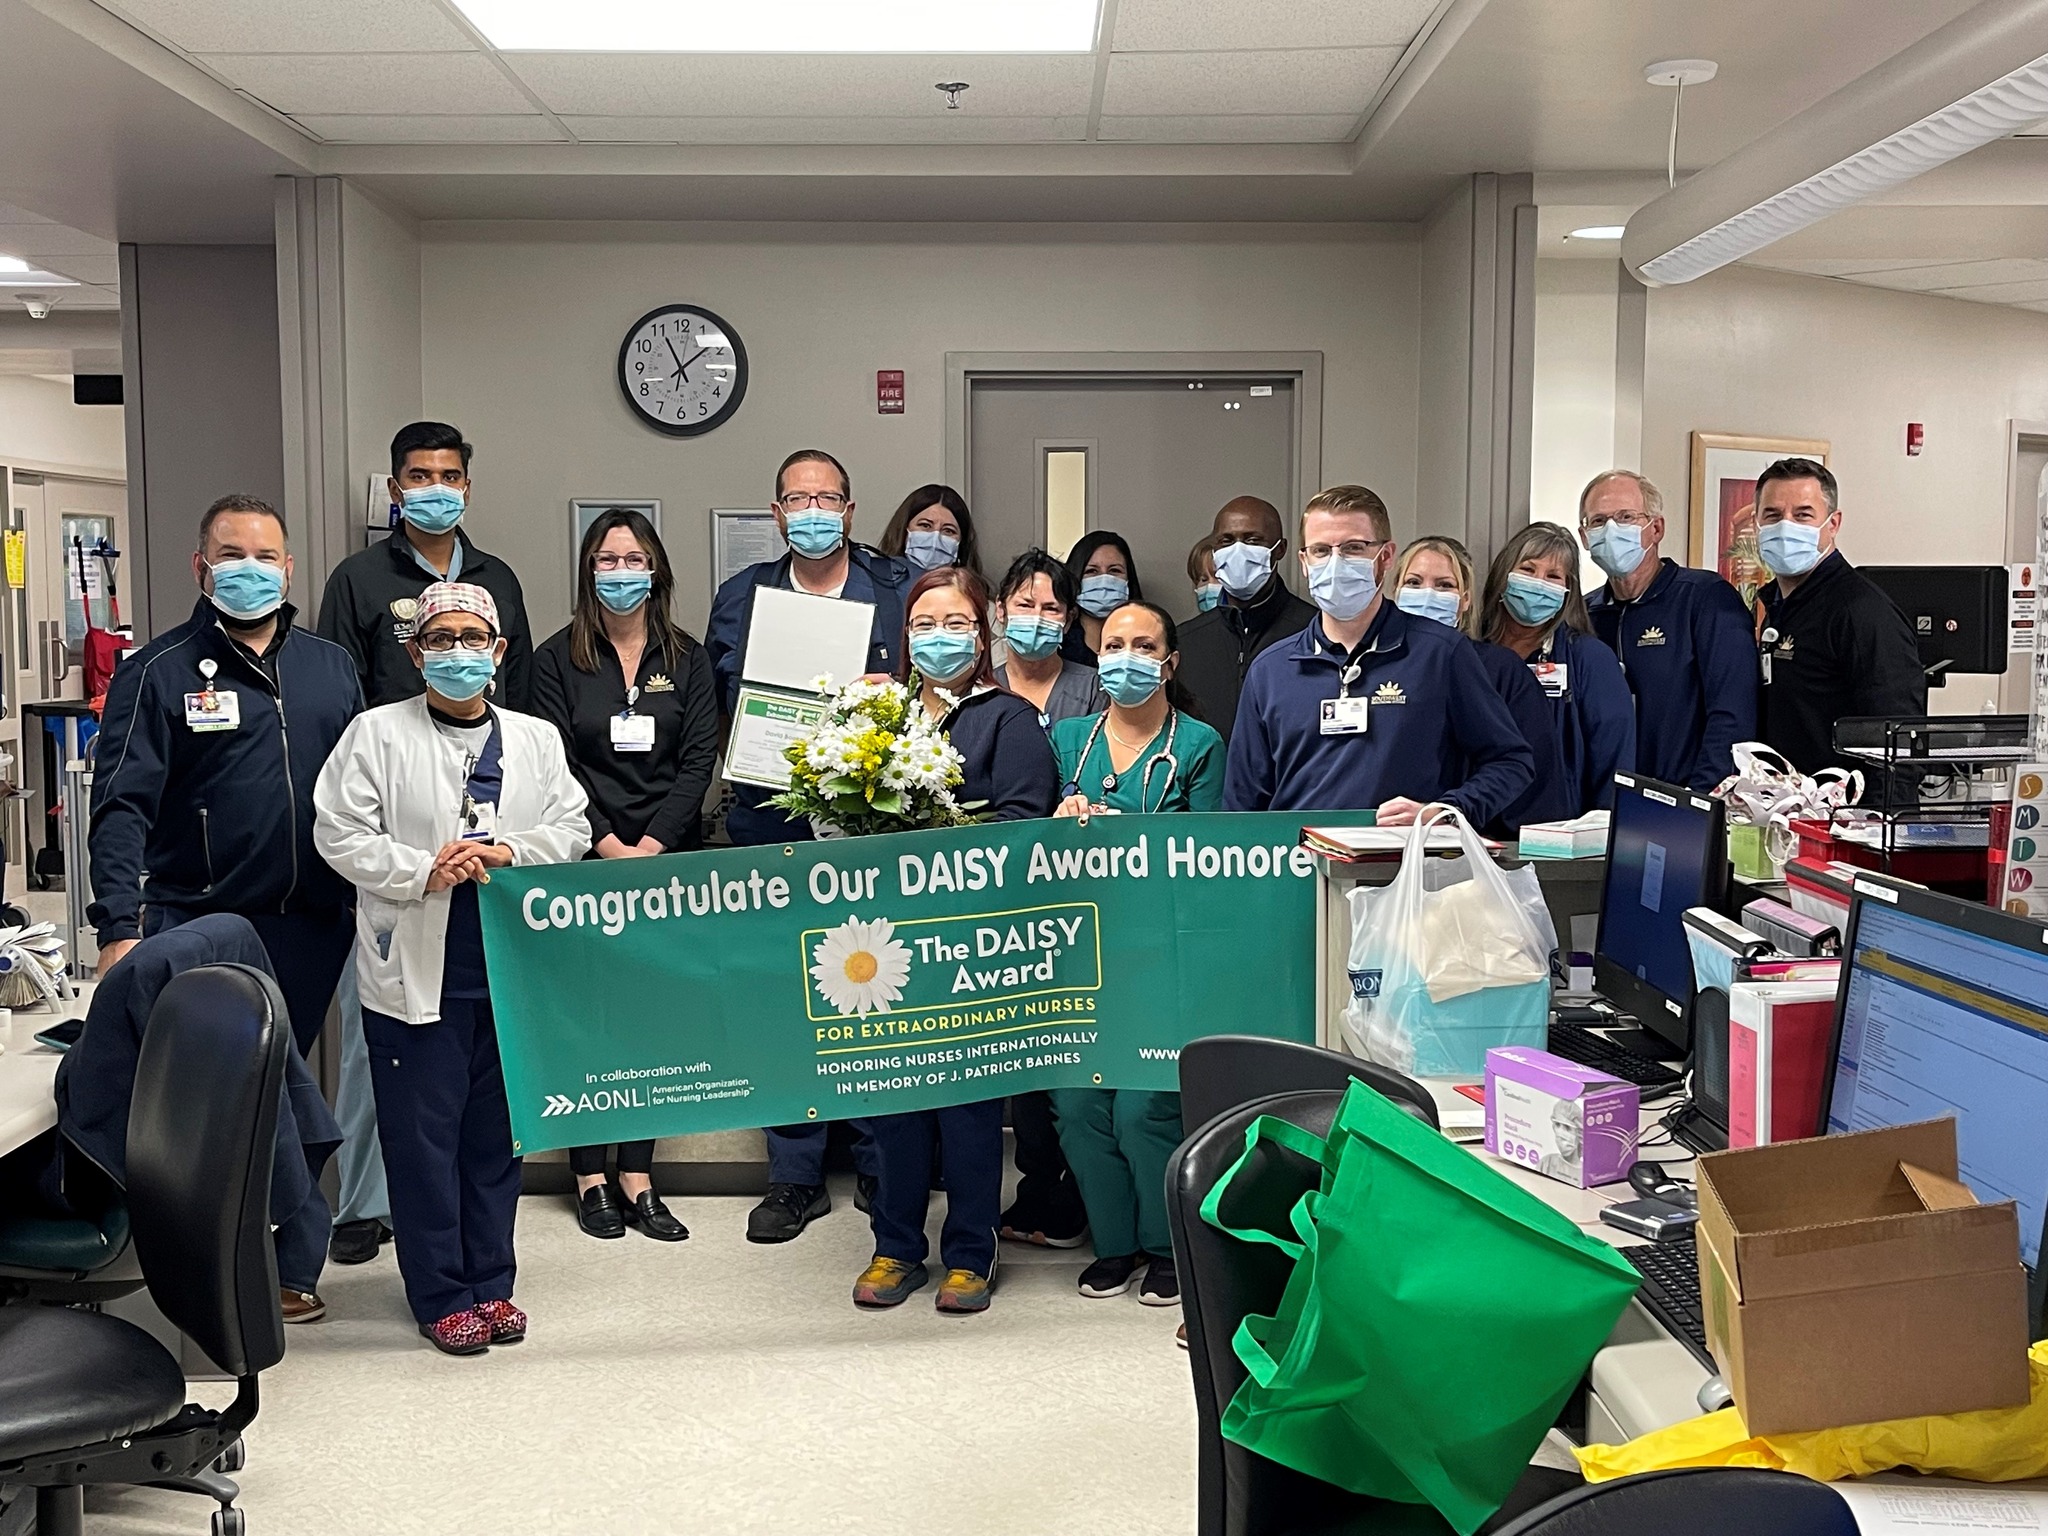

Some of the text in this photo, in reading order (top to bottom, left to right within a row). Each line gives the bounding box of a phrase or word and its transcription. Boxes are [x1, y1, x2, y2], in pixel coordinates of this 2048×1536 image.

[651, 323, 665, 337] 11
[673, 319, 690, 333] 12
[635, 339, 652, 353] 10
[635, 361, 645, 375] 9
[640, 382, 650, 396] 8
[712, 385, 721, 398] 4
[881, 389, 900, 398] FIRE
[656, 401, 664, 414] 7
[676, 406, 686, 420] 6
[699, 402, 708, 416] 5
[2023, 776, 2032, 796] S
[2017, 808, 2031, 826] M
[2018, 839, 2026, 859] T
[522, 869, 791, 936] Congratulate
[808, 861, 880, 904] Our
[898, 845, 1009, 896] DAISY
[1027, 834, 1149, 884] Award
[2010, 870, 2027, 888] W
[914, 916, 1083, 963] The DAISY
[816, 997, 1096, 1042] FOR EXTRAORDINARY NURSES
[816, 1032, 1098, 1076] HONORING NURSES INTERNATIONALLY
[585, 1061, 711, 1084] In collaboration with
[836, 1052, 1081, 1095] IN MEMORY OF J. PATRICK BARNES
[651, 1078, 749, 1094] American Organization
[576, 1088, 646, 1113] AONL
[652, 1096, 665, 1105] for
[666, 1093, 701, 1104] Nursing
[1487, 1125, 1495, 1148] Level
